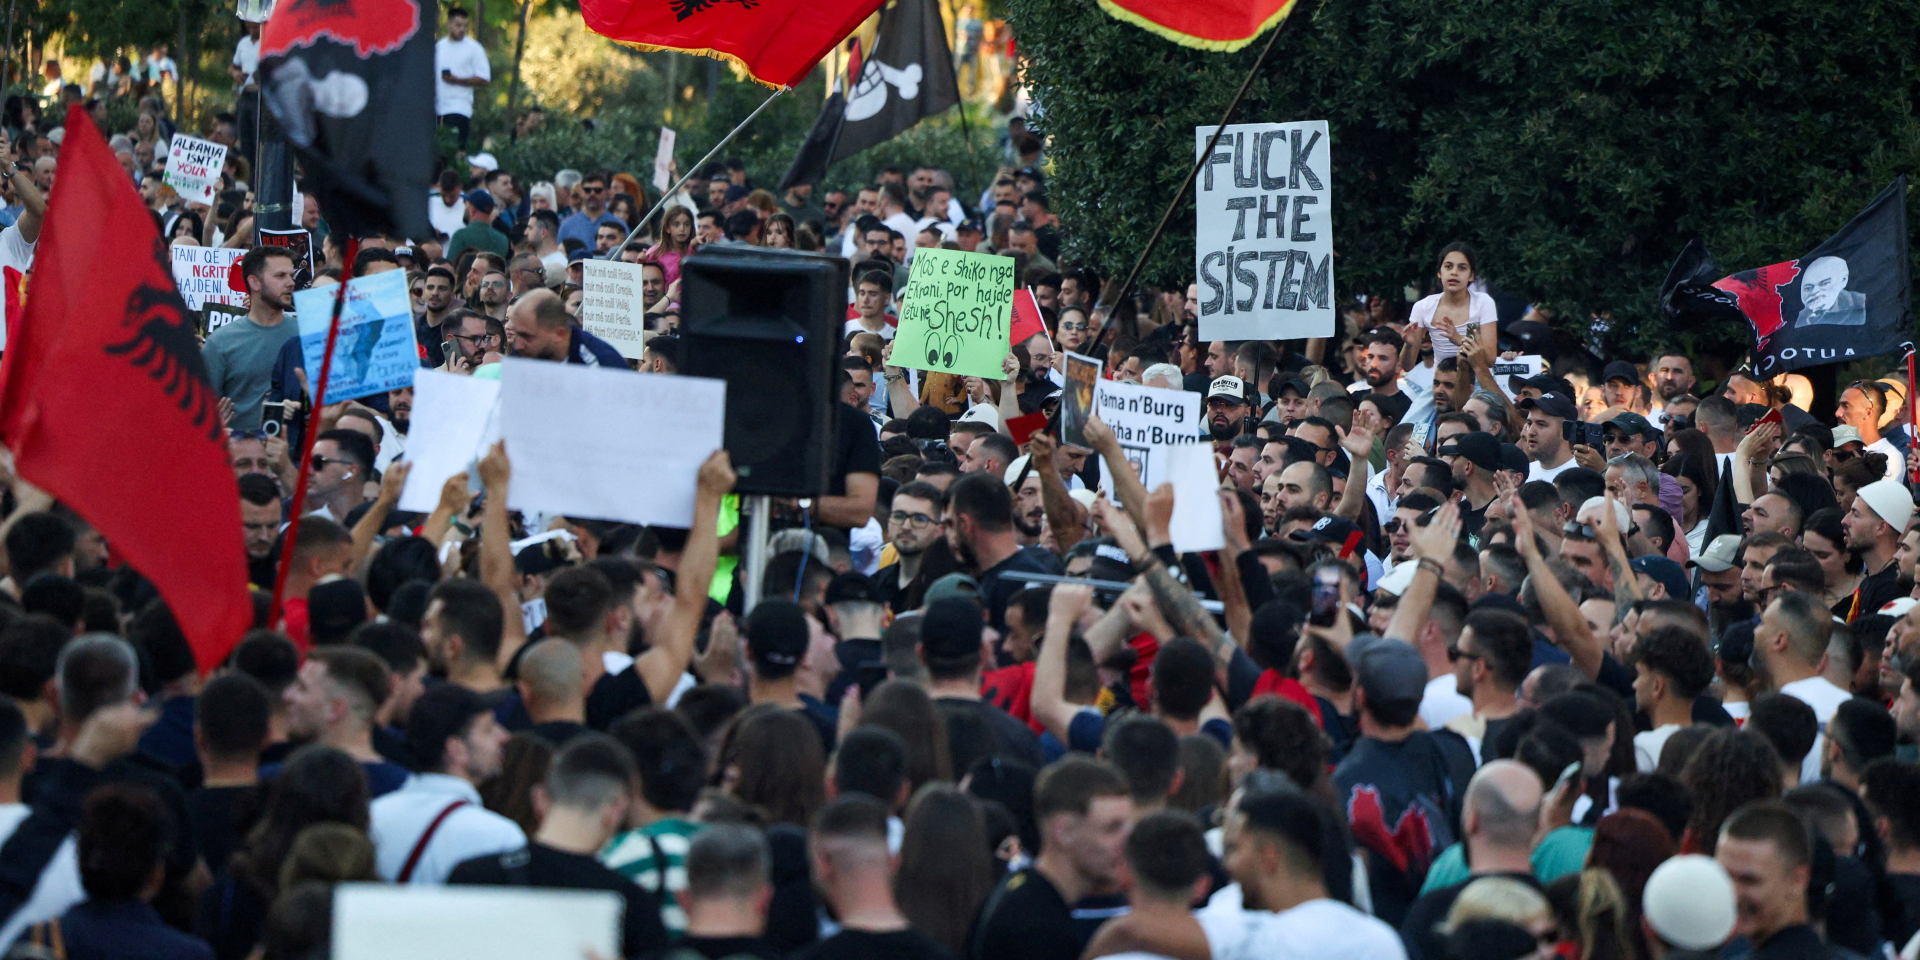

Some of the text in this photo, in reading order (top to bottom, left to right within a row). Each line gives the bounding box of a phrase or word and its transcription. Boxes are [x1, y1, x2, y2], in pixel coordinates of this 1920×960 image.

[174, 137, 223, 159] ALBANIA
[1204, 129, 1324, 191] FUCK
[177, 160, 208, 178] YOUR
[1225, 195, 1318, 242] THE
[174, 247, 197, 262] TANI
[204, 248, 220, 264] QË
[909, 252, 937, 280] Mos
[942, 259, 949, 274] e
[990, 264, 1013, 285] nga
[947, 281, 968, 300] por
[976, 282, 1012, 307] hajde
